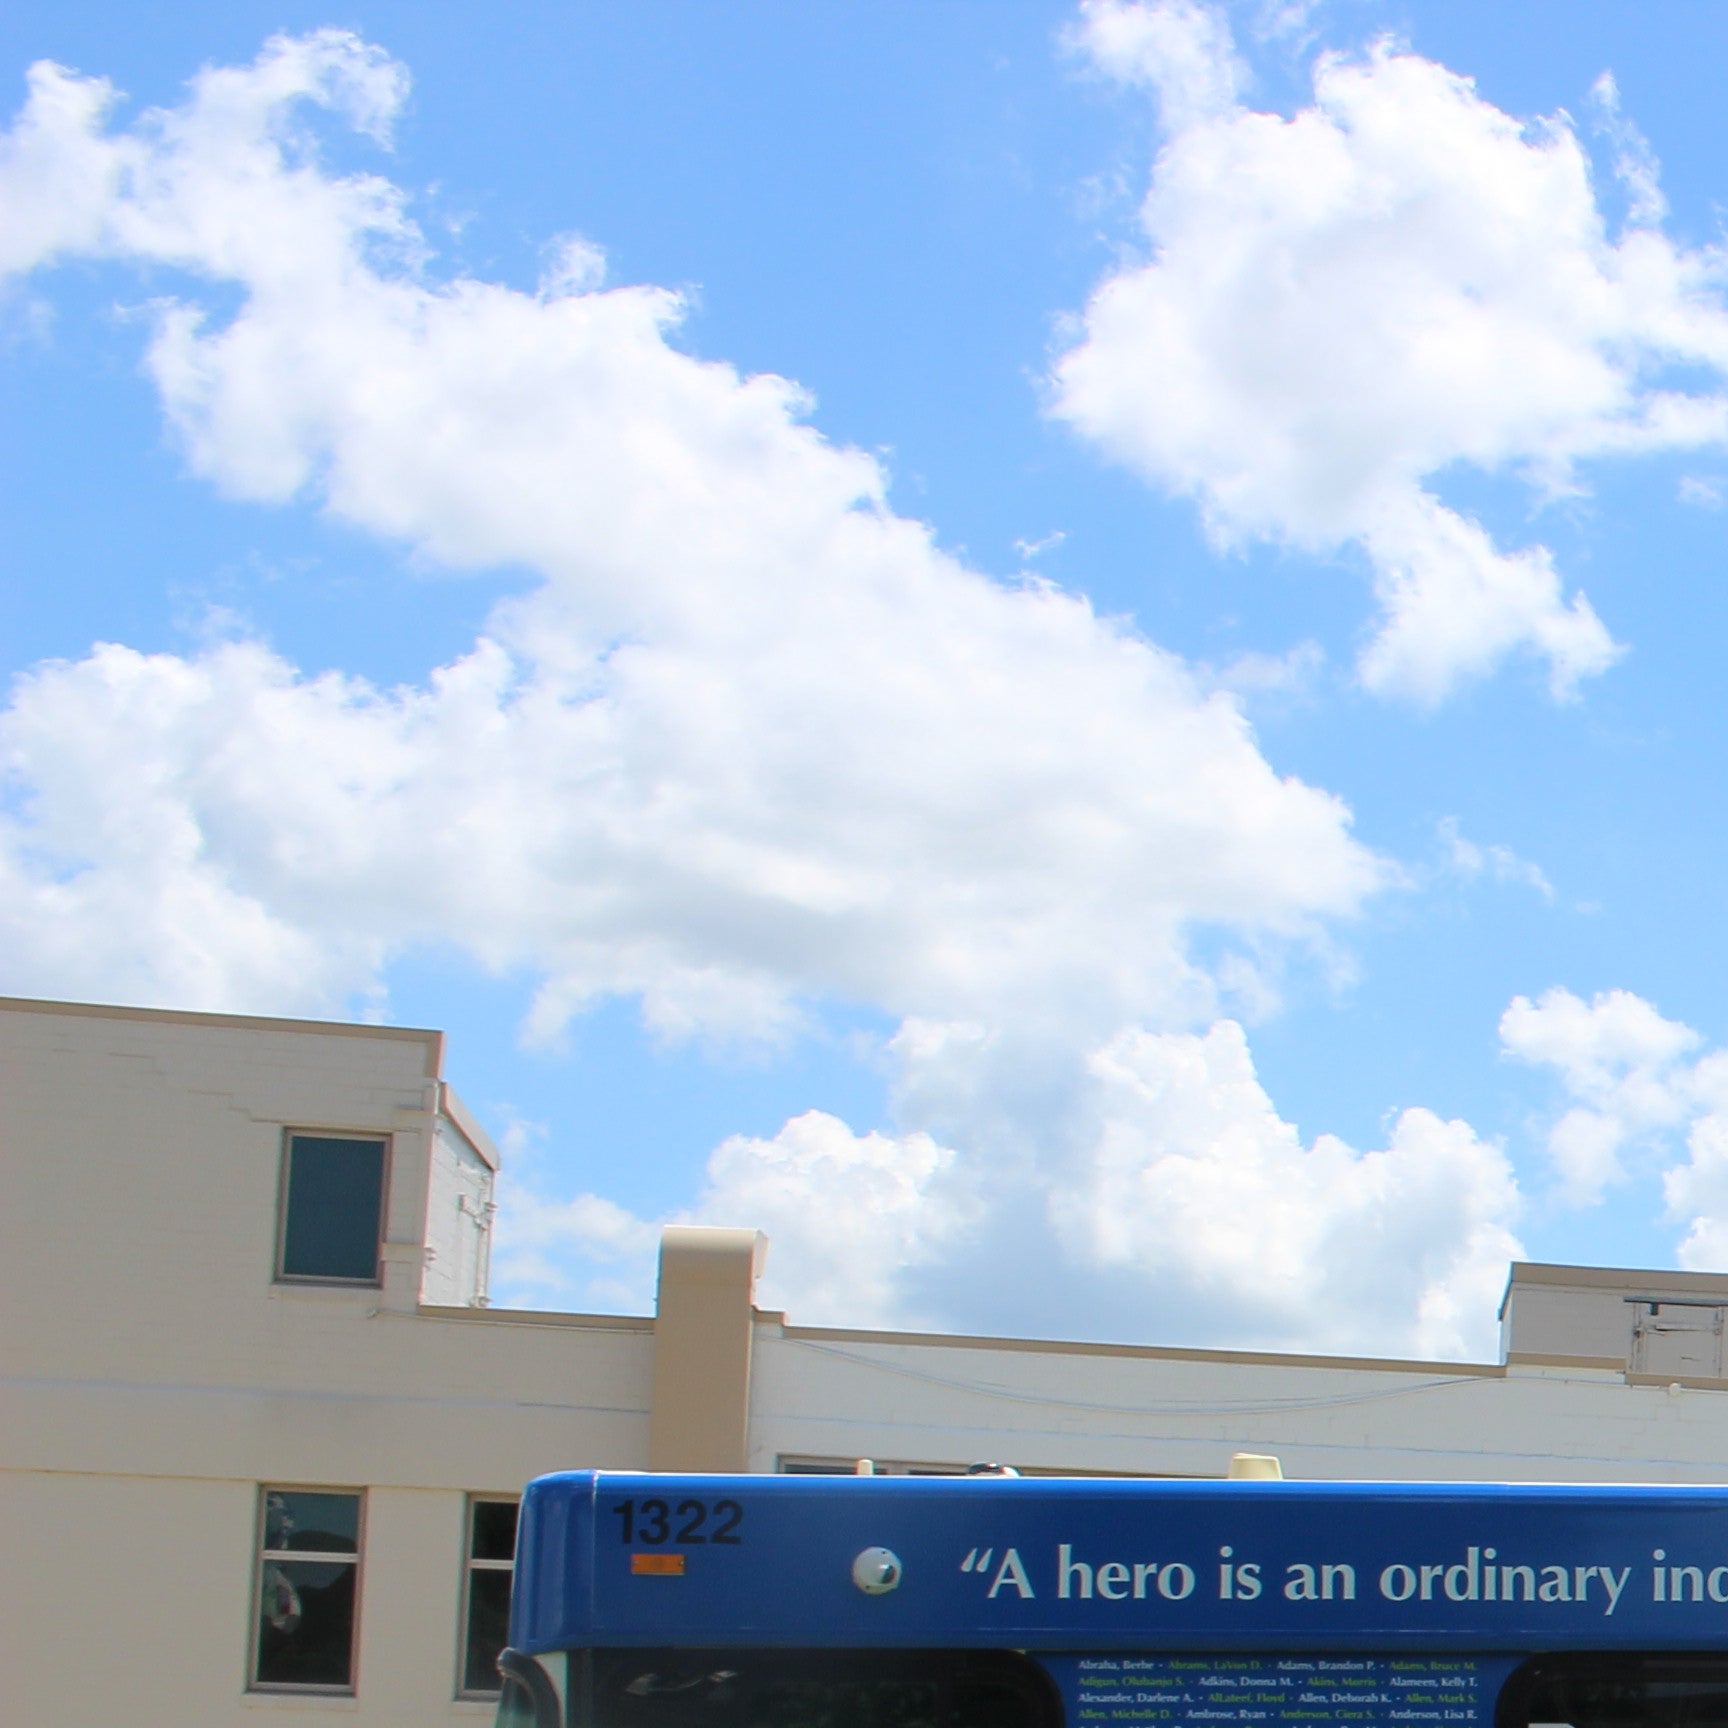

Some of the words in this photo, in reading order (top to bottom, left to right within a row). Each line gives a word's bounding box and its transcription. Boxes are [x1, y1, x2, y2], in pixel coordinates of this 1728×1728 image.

[613, 1499, 744, 1546] 1322
[1059, 1545, 1193, 1599] hero
[1220, 1546, 1259, 1599] is
[1285, 1564, 1354, 1599] an
[1380, 1547, 1630, 1615] ordinary
[1277, 1661, 1315, 1671] Adams,
[1319, 1661, 1364, 1670] Brandon
[1441, 1677, 1465, 1687] Kelly
[1299, 1693, 1328, 1703] Allen,
[1332, 1693, 1378, 1702] Deborah
[1187, 1709, 1237, 1719] Ambrose,
[1240, 1710, 1266, 1719] Ryan
[1390, 1709, 1441, 1719] Anderson,
[1445, 1710, 1464, 1719] Lisa
